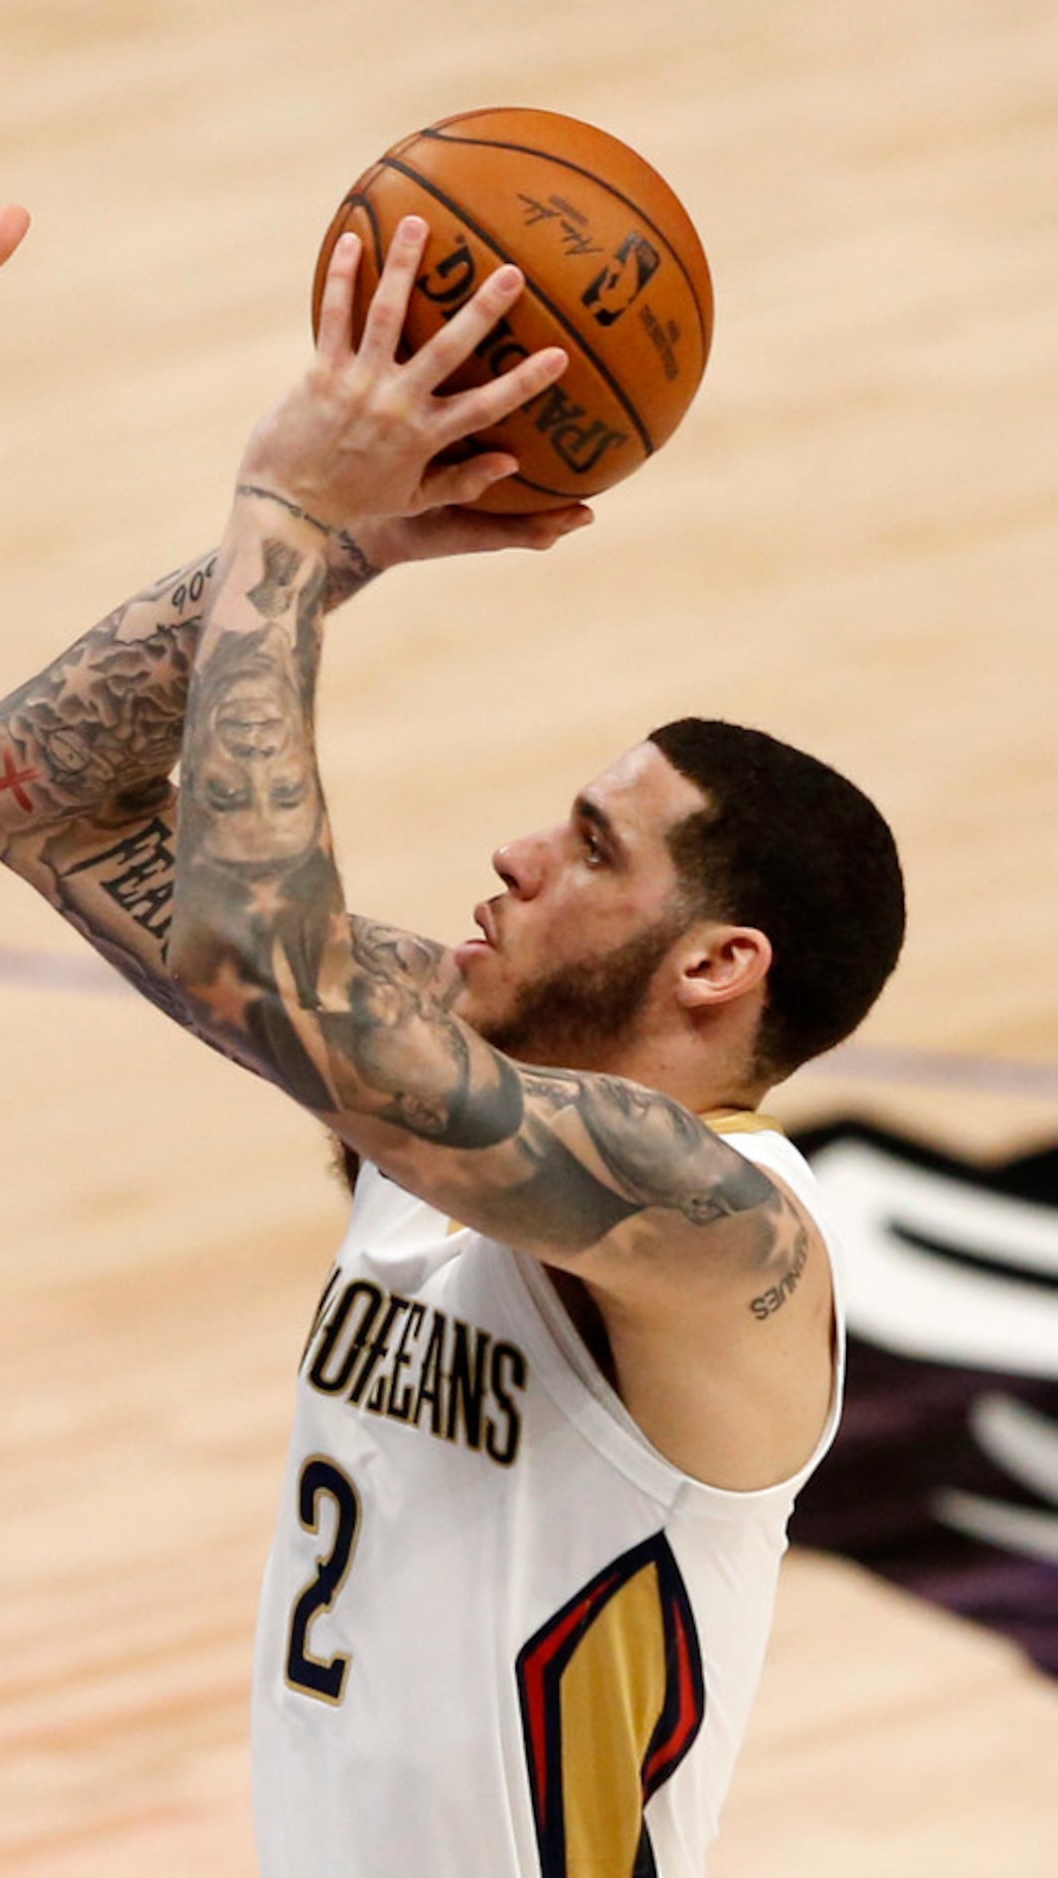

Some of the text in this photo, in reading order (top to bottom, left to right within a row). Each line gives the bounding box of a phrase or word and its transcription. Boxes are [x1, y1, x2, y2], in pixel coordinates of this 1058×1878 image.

[416, 245, 629, 474] SPADIG
[60, 816, 176, 964] FEA
[283, 1453, 362, 1708] 2
